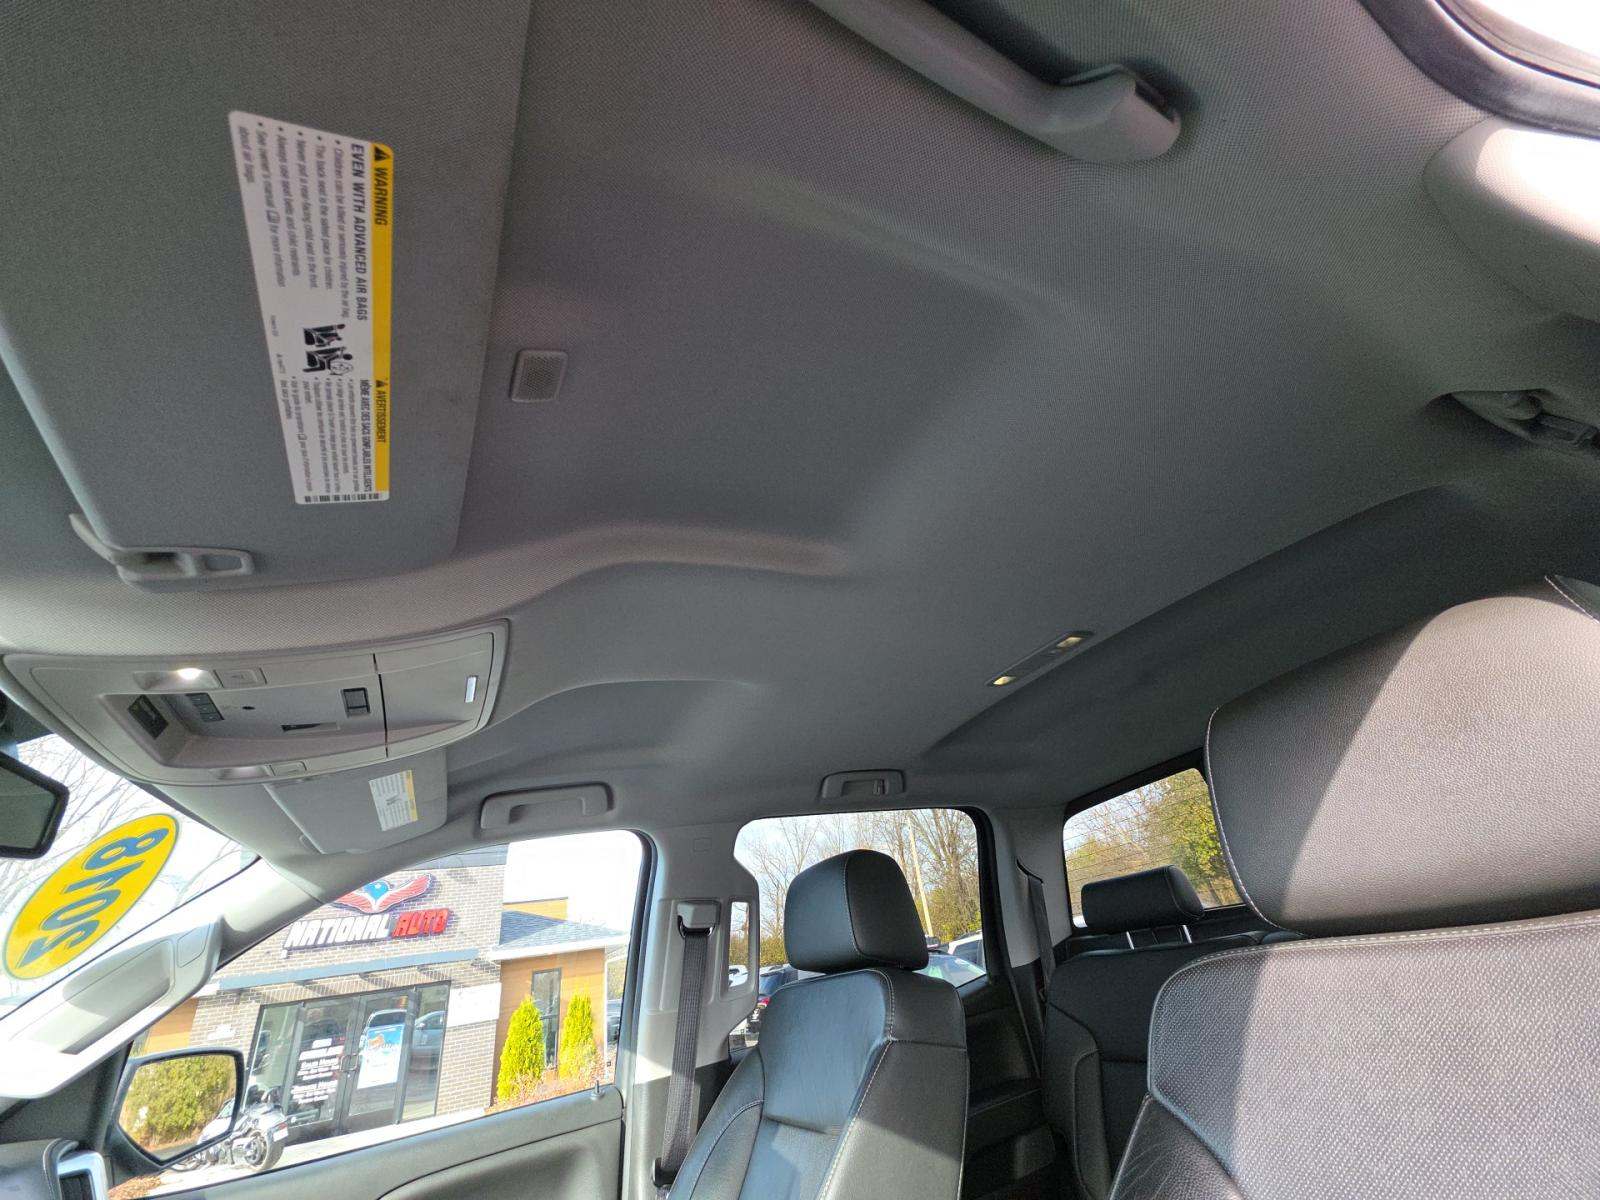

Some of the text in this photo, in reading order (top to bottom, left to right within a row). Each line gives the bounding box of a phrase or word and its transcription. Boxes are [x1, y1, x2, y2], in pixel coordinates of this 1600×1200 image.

[315, 146, 326, 159] The
[316, 160, 326, 177] back
[374, 167, 388, 226] WARNING
[352, 144, 368, 320] EVEN WITH ADVANCED AIR BAGS
[360, 380, 372, 492] MÊME AVEC DES SACS GONFLABLES INTELLIGENTS
[376, 390, 386, 443] AVERTISSEMENT
[284, 908, 450, 949] NATIONAL AUTO
